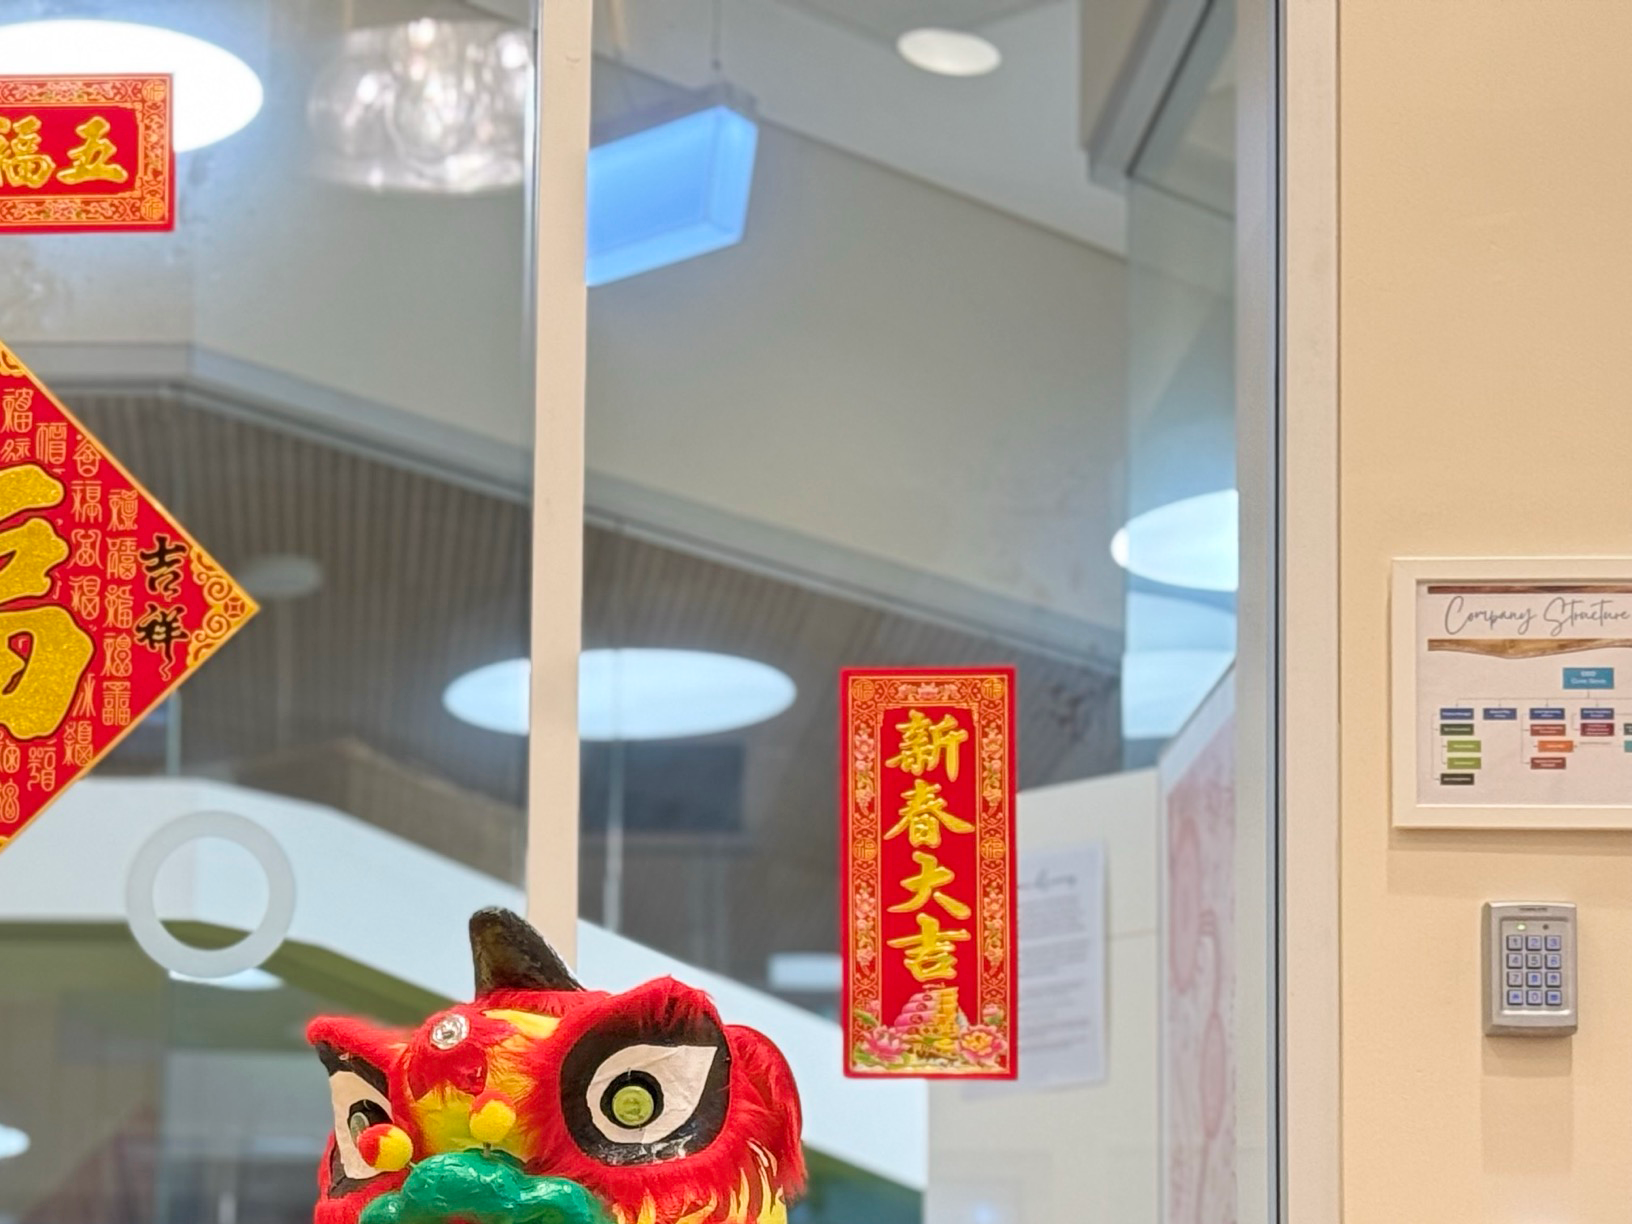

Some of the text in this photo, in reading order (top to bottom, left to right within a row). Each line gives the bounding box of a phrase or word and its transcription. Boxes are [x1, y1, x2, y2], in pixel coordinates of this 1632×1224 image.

[133, 532, 191, 681] 吉祥
[1444, 595, 1630, 637] Company Structure
[883, 709, 975, 983] 新春大吉
